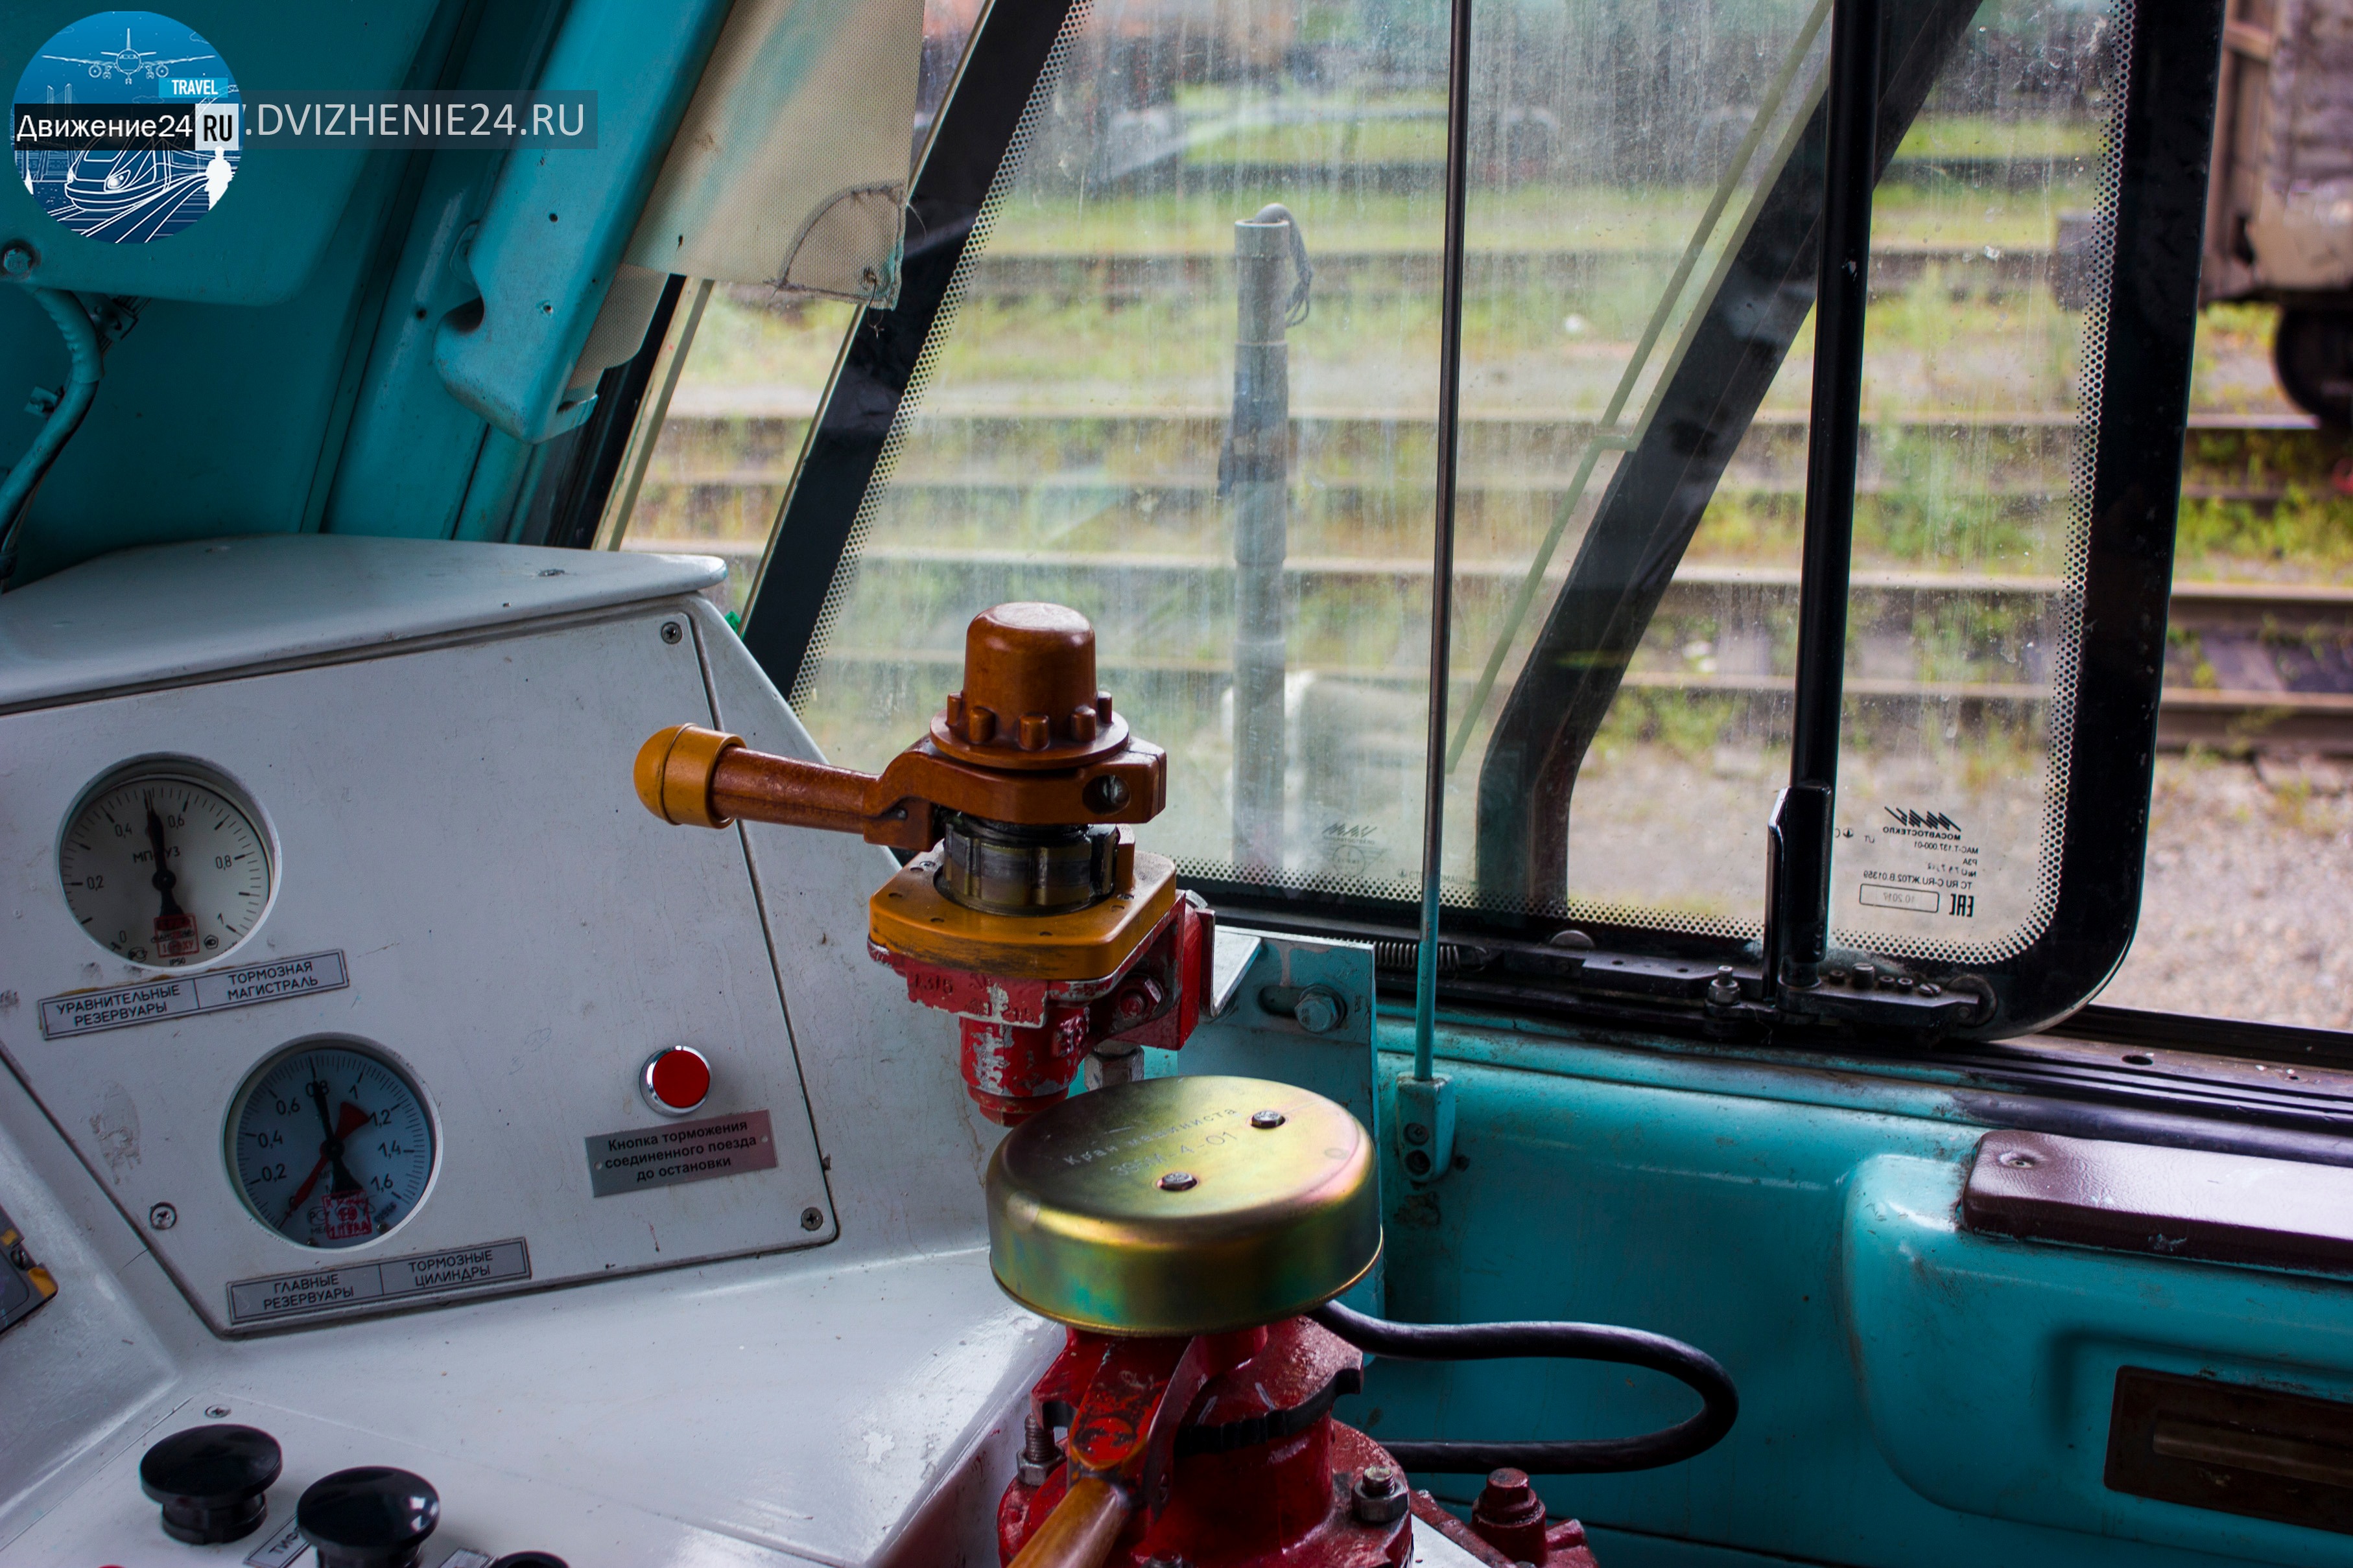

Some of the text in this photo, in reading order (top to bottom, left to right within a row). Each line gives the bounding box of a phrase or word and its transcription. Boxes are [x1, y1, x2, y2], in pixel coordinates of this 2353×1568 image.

[115, 824, 132, 839] 0,4
[168, 816, 185, 830] 0,6
[215, 855, 233, 871] 0,8
[87, 876, 104, 891] 0,2
[228, 961, 313, 985] ТОРМОЗНАЯ
[228, 976, 319, 1001] МАГИСТРАЛЬ
[56, 984, 180, 1016] УРАВНИТЕЛЬНЫЕ
[74, 1002, 167, 1027] РЕЗЕРВУАРЫ
[305, 1080, 330, 1098] 08
[348, 1084, 359, 1100] 1
[275, 1097, 301, 1116] 0,6
[368, 1109, 392, 1128] 1,2
[257, 1130, 283, 1149] 0,4
[608, 1121, 748, 1153] Кнопка торможения
[377, 1140, 401, 1158] 1,4
[605, 1135, 757, 1169] соединенного поезда
[262, 1163, 287, 1183] 0,2
[637, 1157, 731, 1183] до остановки
[370, 1173, 394, 1193] 1,6
[408, 1249, 493, 1274] ТОРМОЗНЫЕ
[274, 1273, 339, 1294] ГЛАВНЫЕ
[414, 1265, 491, 1288] ЦИЛИНДРЫ
[263, 1285, 354, 1311] РЕЗЕРВУАРЫ
